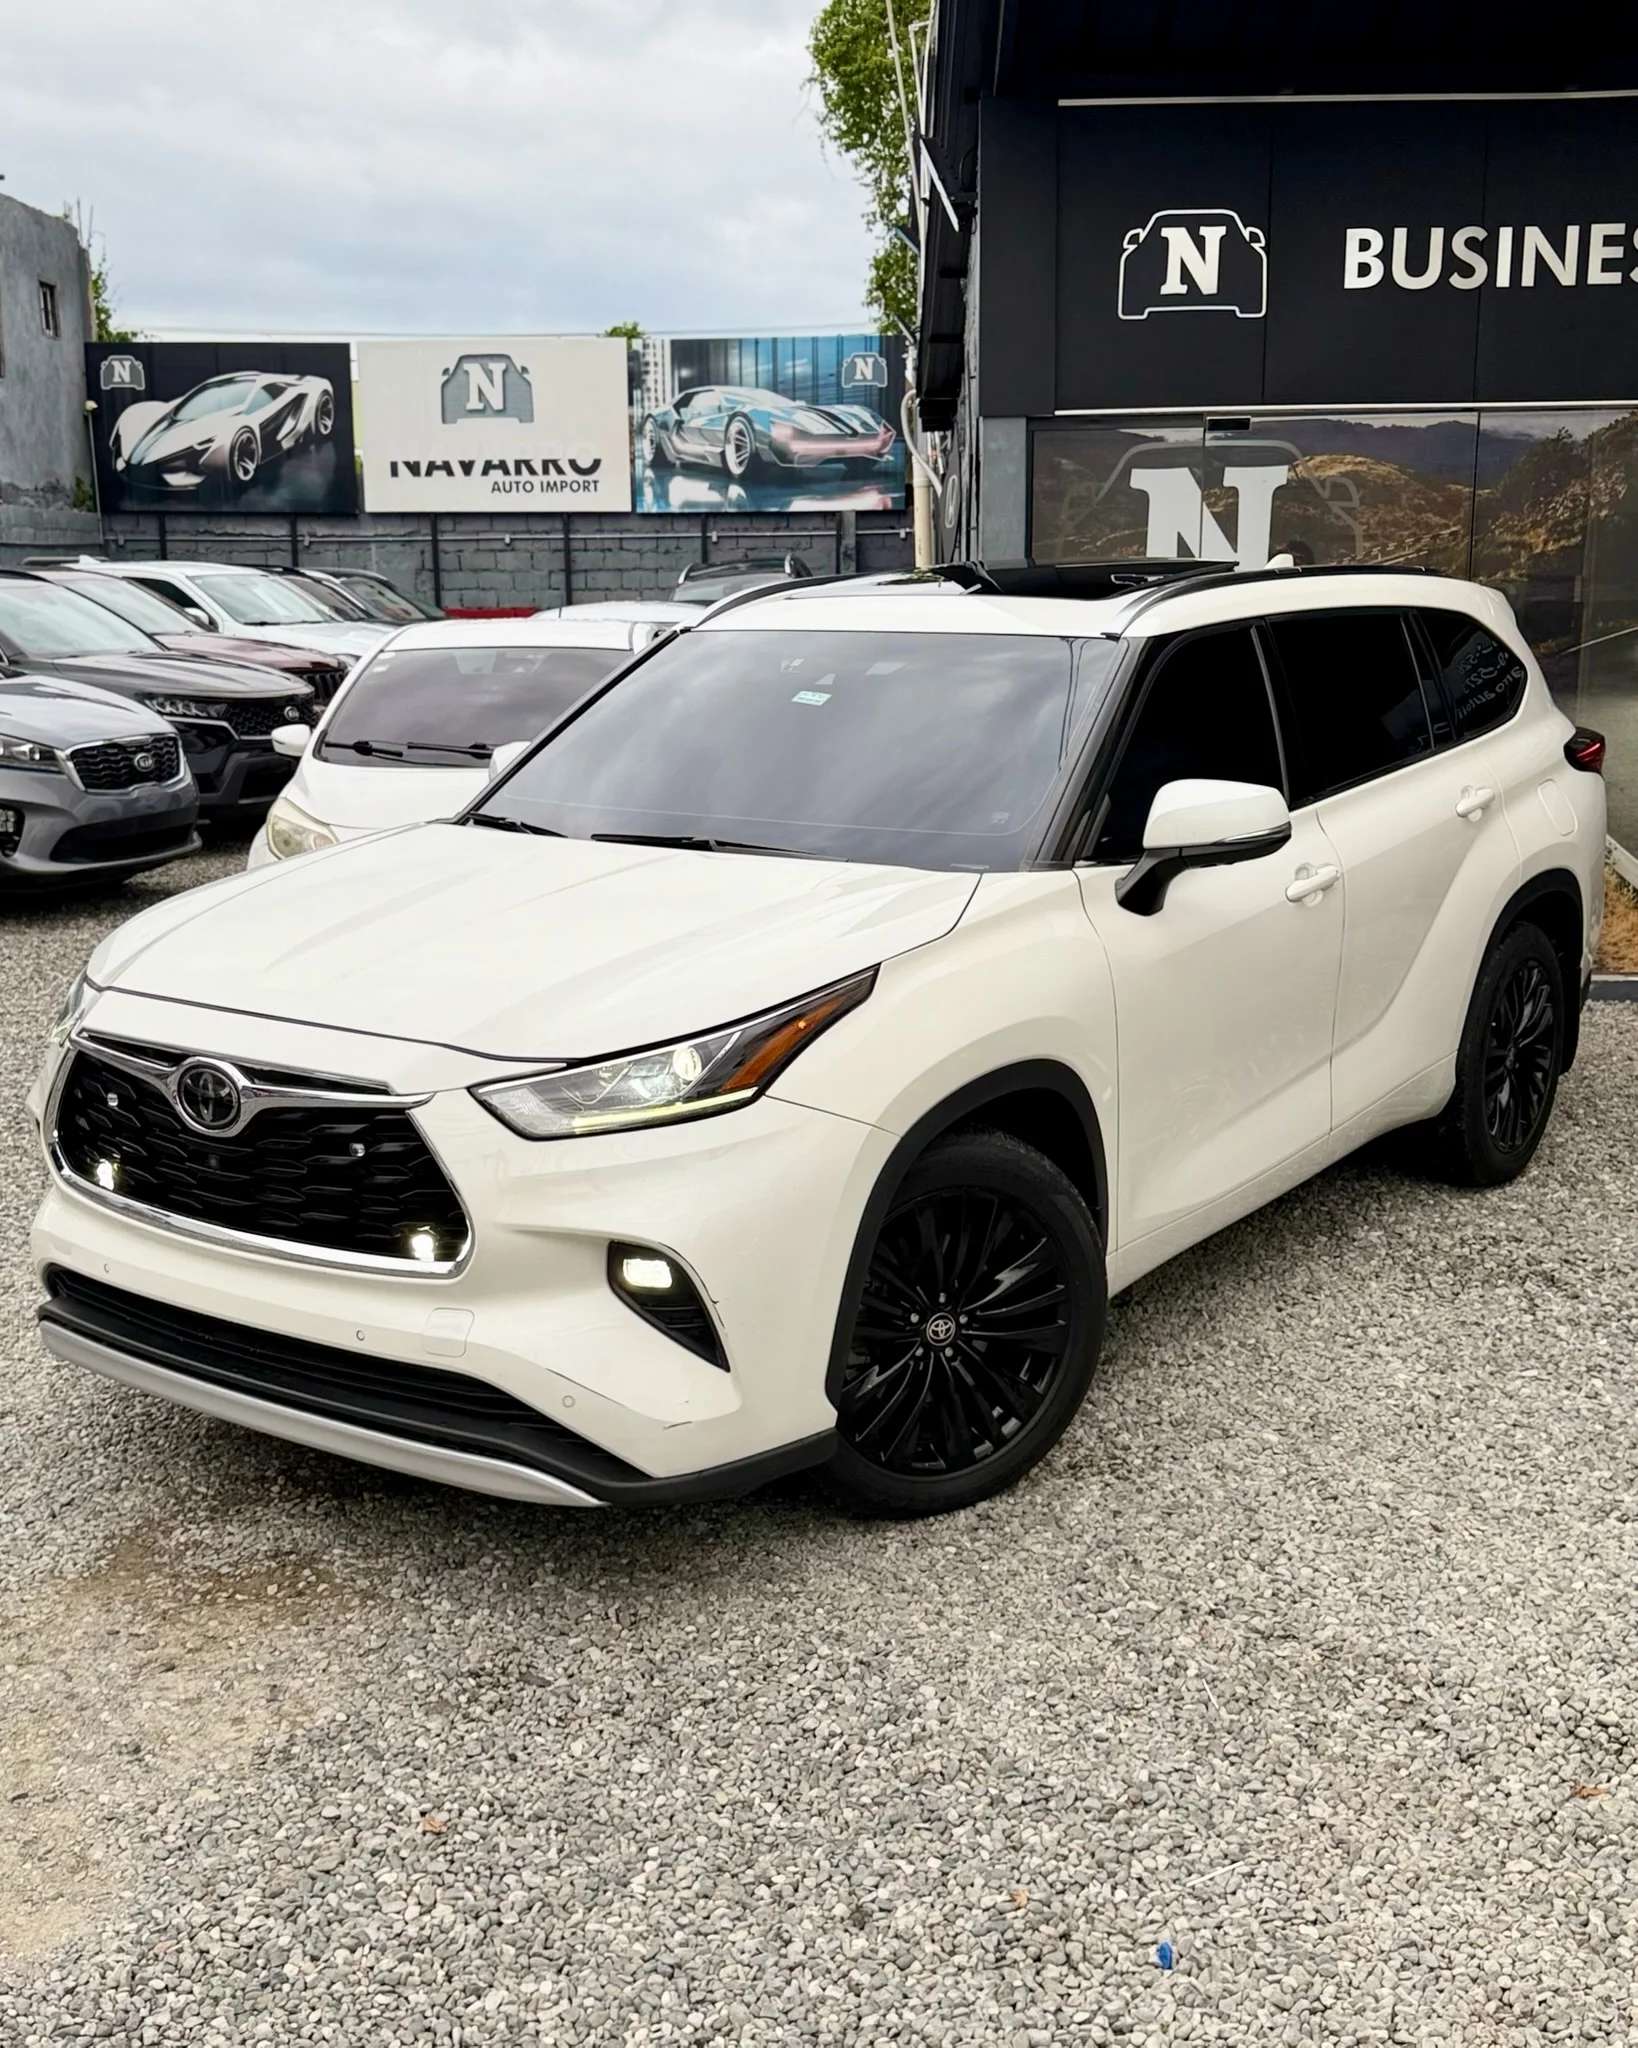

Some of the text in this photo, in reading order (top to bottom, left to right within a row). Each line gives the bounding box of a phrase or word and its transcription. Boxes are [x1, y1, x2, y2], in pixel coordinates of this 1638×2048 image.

[1160, 225, 1227, 296] N
[1343, 222, 1638, 291] BUSINE
[111, 360, 131, 383] N
[463, 362, 507, 411] N
[854, 357, 876, 380] N
[491, 479, 600, 494] AUTO IMPORT
[1129, 465, 1289, 572] N
